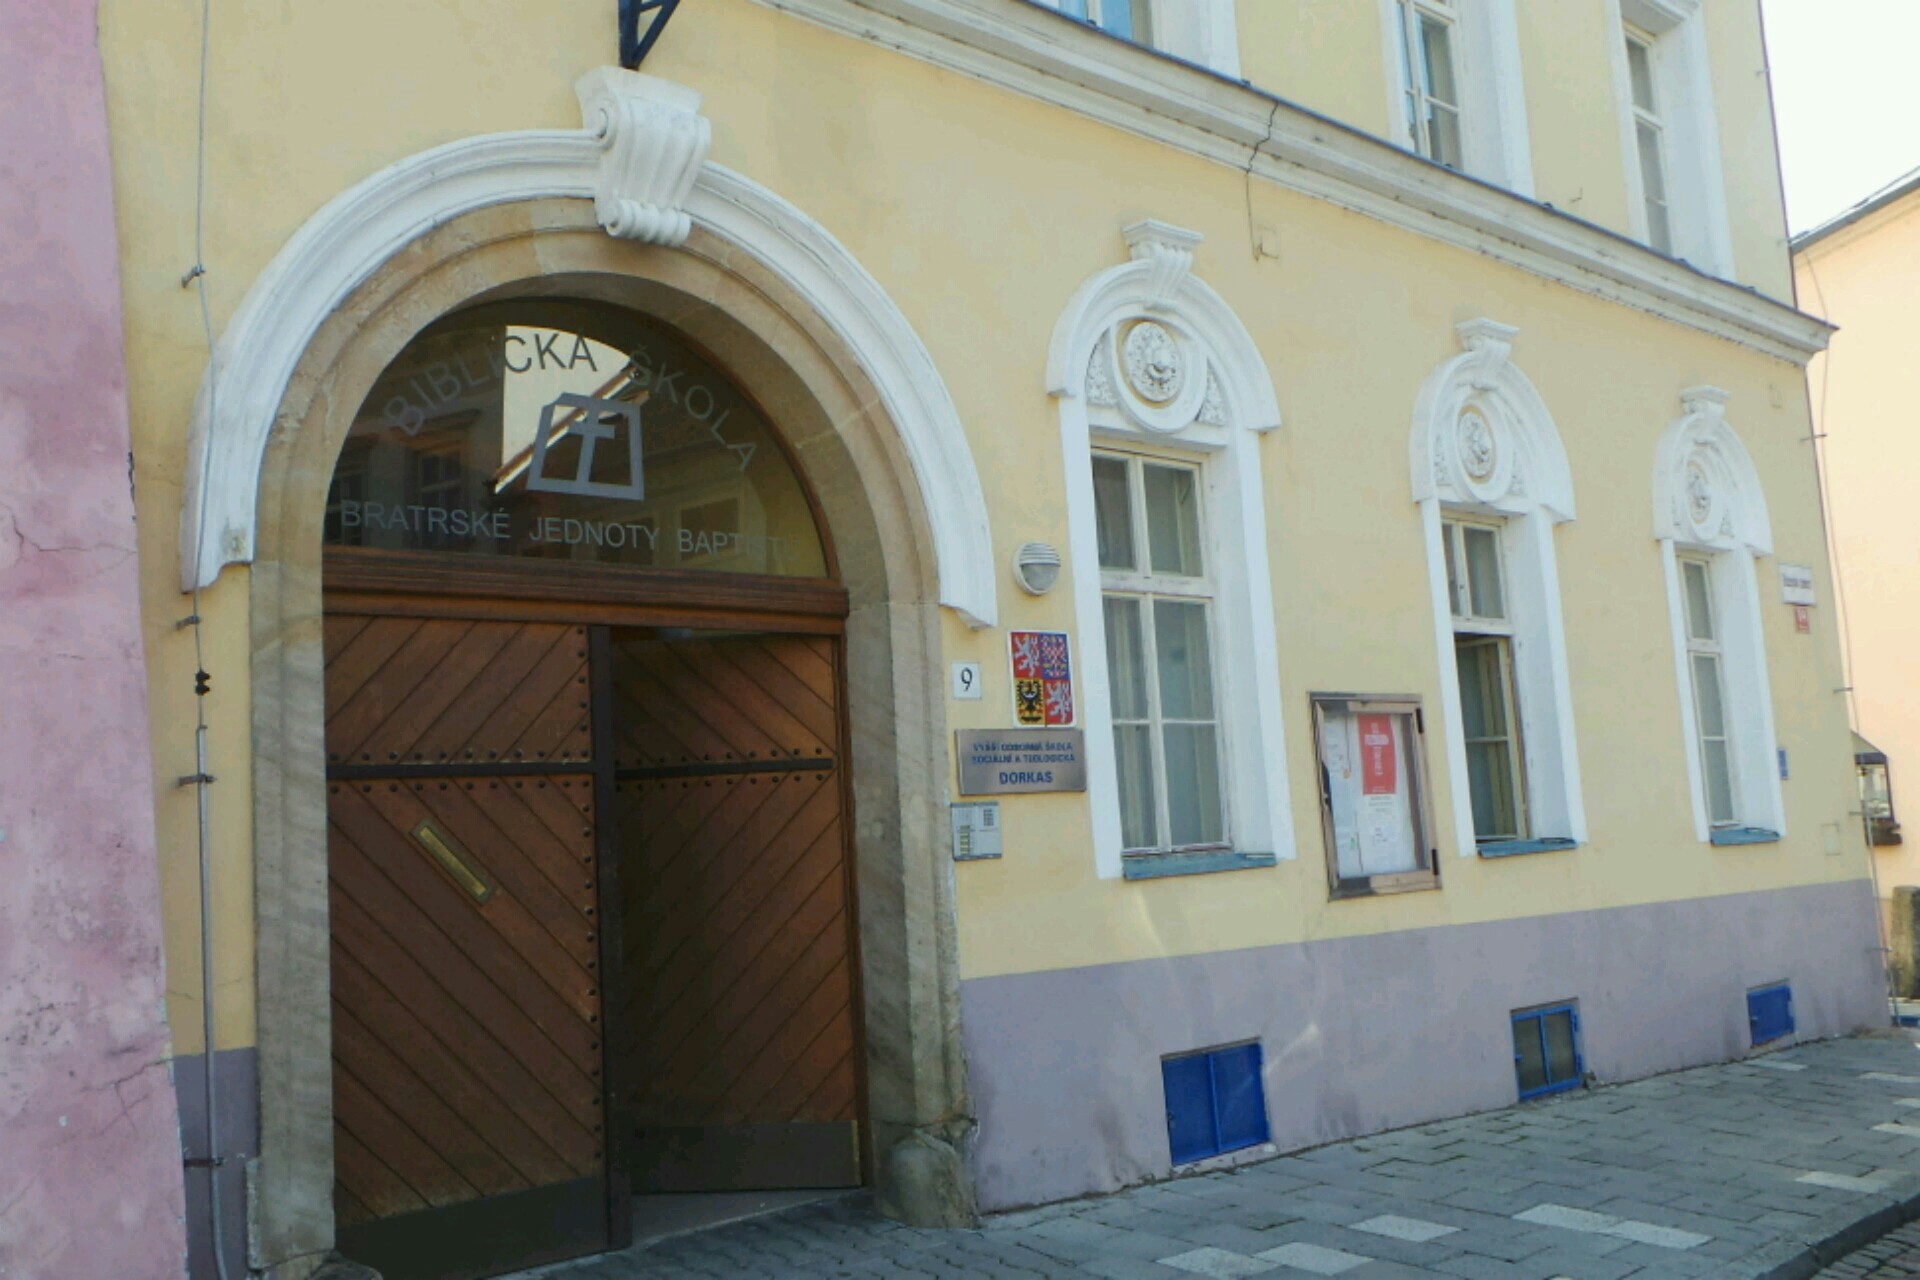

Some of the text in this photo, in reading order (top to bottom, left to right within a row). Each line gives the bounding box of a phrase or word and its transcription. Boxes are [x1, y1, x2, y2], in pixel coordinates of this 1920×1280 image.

[629, 344, 757, 471] ŠKOLA
[341, 500, 511, 539] BRATRSKÉ
[529, 517, 660, 550] JEDNOTY
[960, 667, 973, 691] 9
[999, 771, 1053, 785] DORKAS
